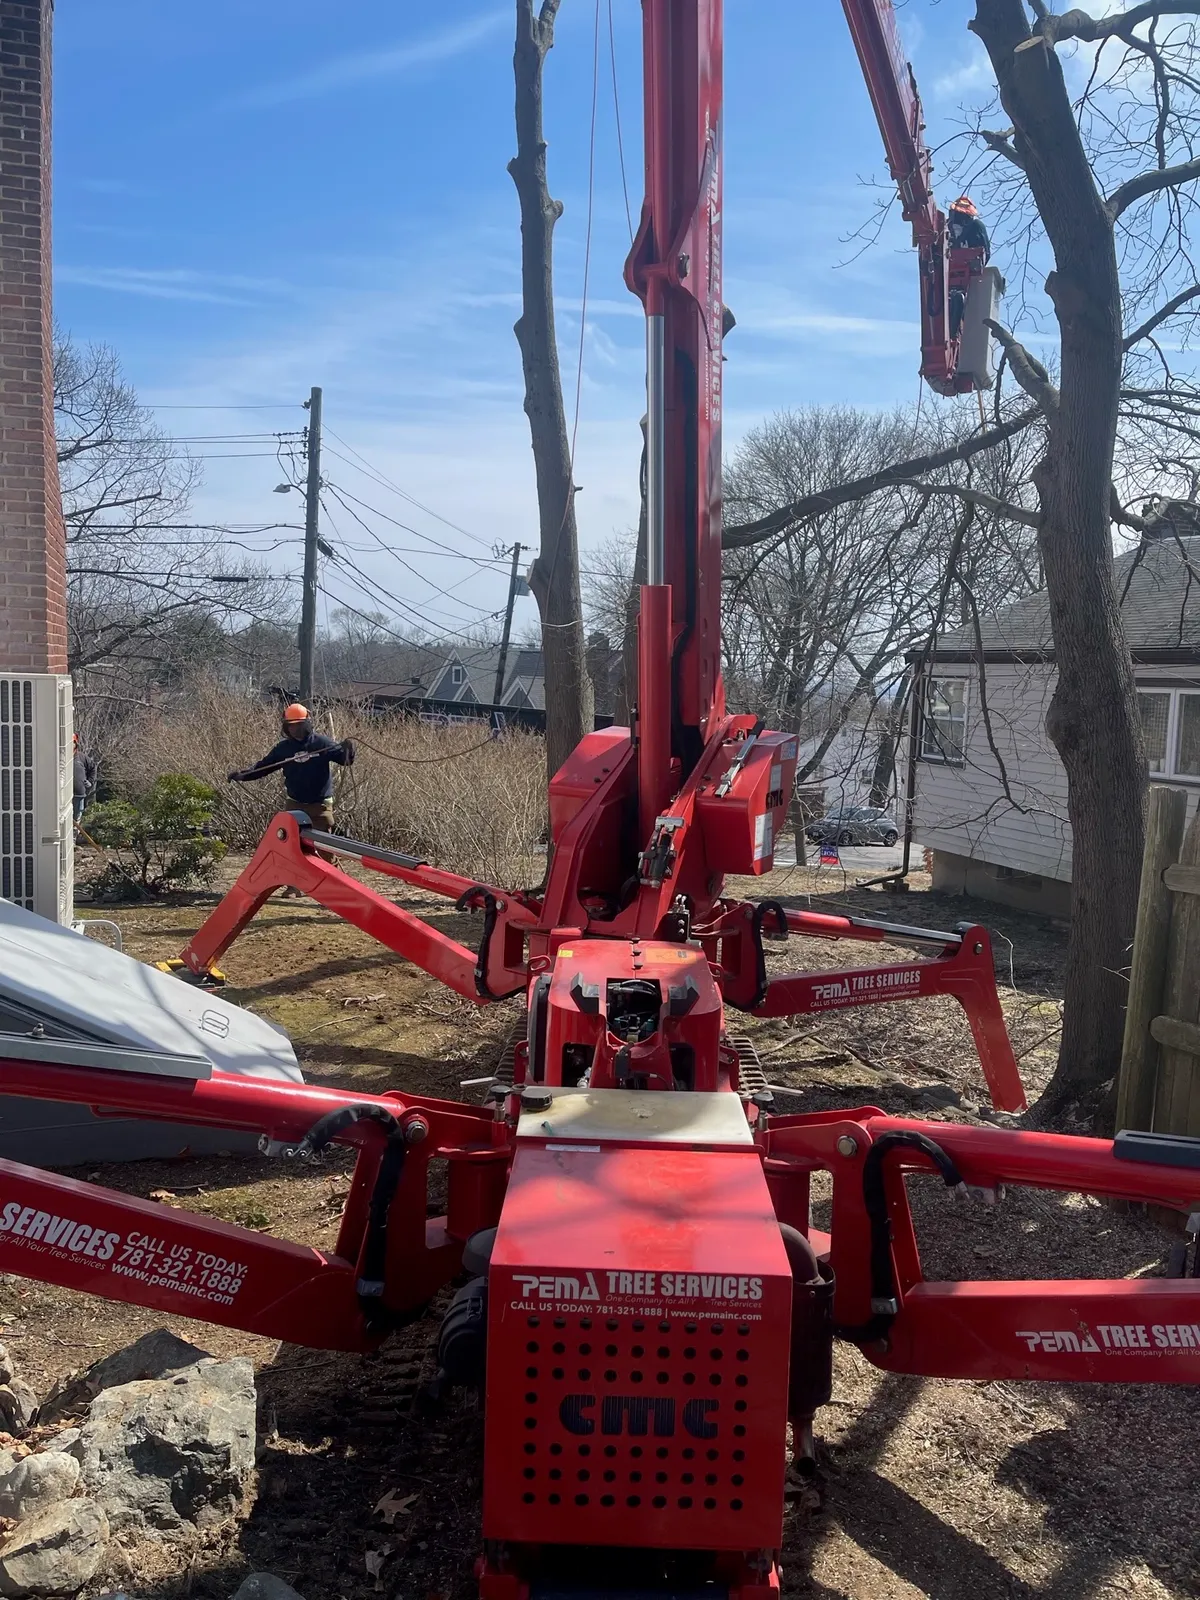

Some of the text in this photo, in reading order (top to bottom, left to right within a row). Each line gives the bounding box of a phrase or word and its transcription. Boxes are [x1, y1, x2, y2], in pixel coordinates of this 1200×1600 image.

[713, 233, 721, 294] TREE
[712, 300, 721, 422] SERVICES
[811, 978, 851, 1000] PEMA
[852, 975, 875, 991] TREE
[876, 970, 921, 988] SERVICES
[810, 1000, 823, 1008] CALL
[0, 1202, 121, 1261] SERVICES
[10, 1236, 27, 1248] All
[27, 1240, 47, 1253] Your
[48, 1246, 68, 1260] Tree
[69, 1252, 106, 1270] Services
[126, 1231, 248, 1278] CALL US TODAY:
[111, 1263, 234, 1305] www.pemainc.com
[117, 1245, 242, 1294] 781-321-1888
[512, 1271, 763, 1300] PEMA TREE SERVICES
[605, 1294, 622, 1302] One
[626, 1295, 662, 1305] Company
[665, 1296, 677, 1305] for
[678, 1297, 690, 1305] All
[510, 1301, 535, 1311] CALL
[539, 1302, 552, 1312] US
[555, 1303, 593, 1314] TODAY:
[596, 1305, 663, 1317] 781-321-1888
[670, 1310, 762, 1321] www.pemainc.com
[711, 1299, 728, 1307] Tree
[729, 1300, 762, 1309] Services
[1015, 1331, 1101, 1353] PEMA
[1096, 1325, 1151, 1347] TREE
[1105, 1348, 1122, 1356] One
[1124, 1348, 1163, 1358] Company
[1164, 1347, 1175, 1356] for
[1177, 1347, 1189, 1356] All
